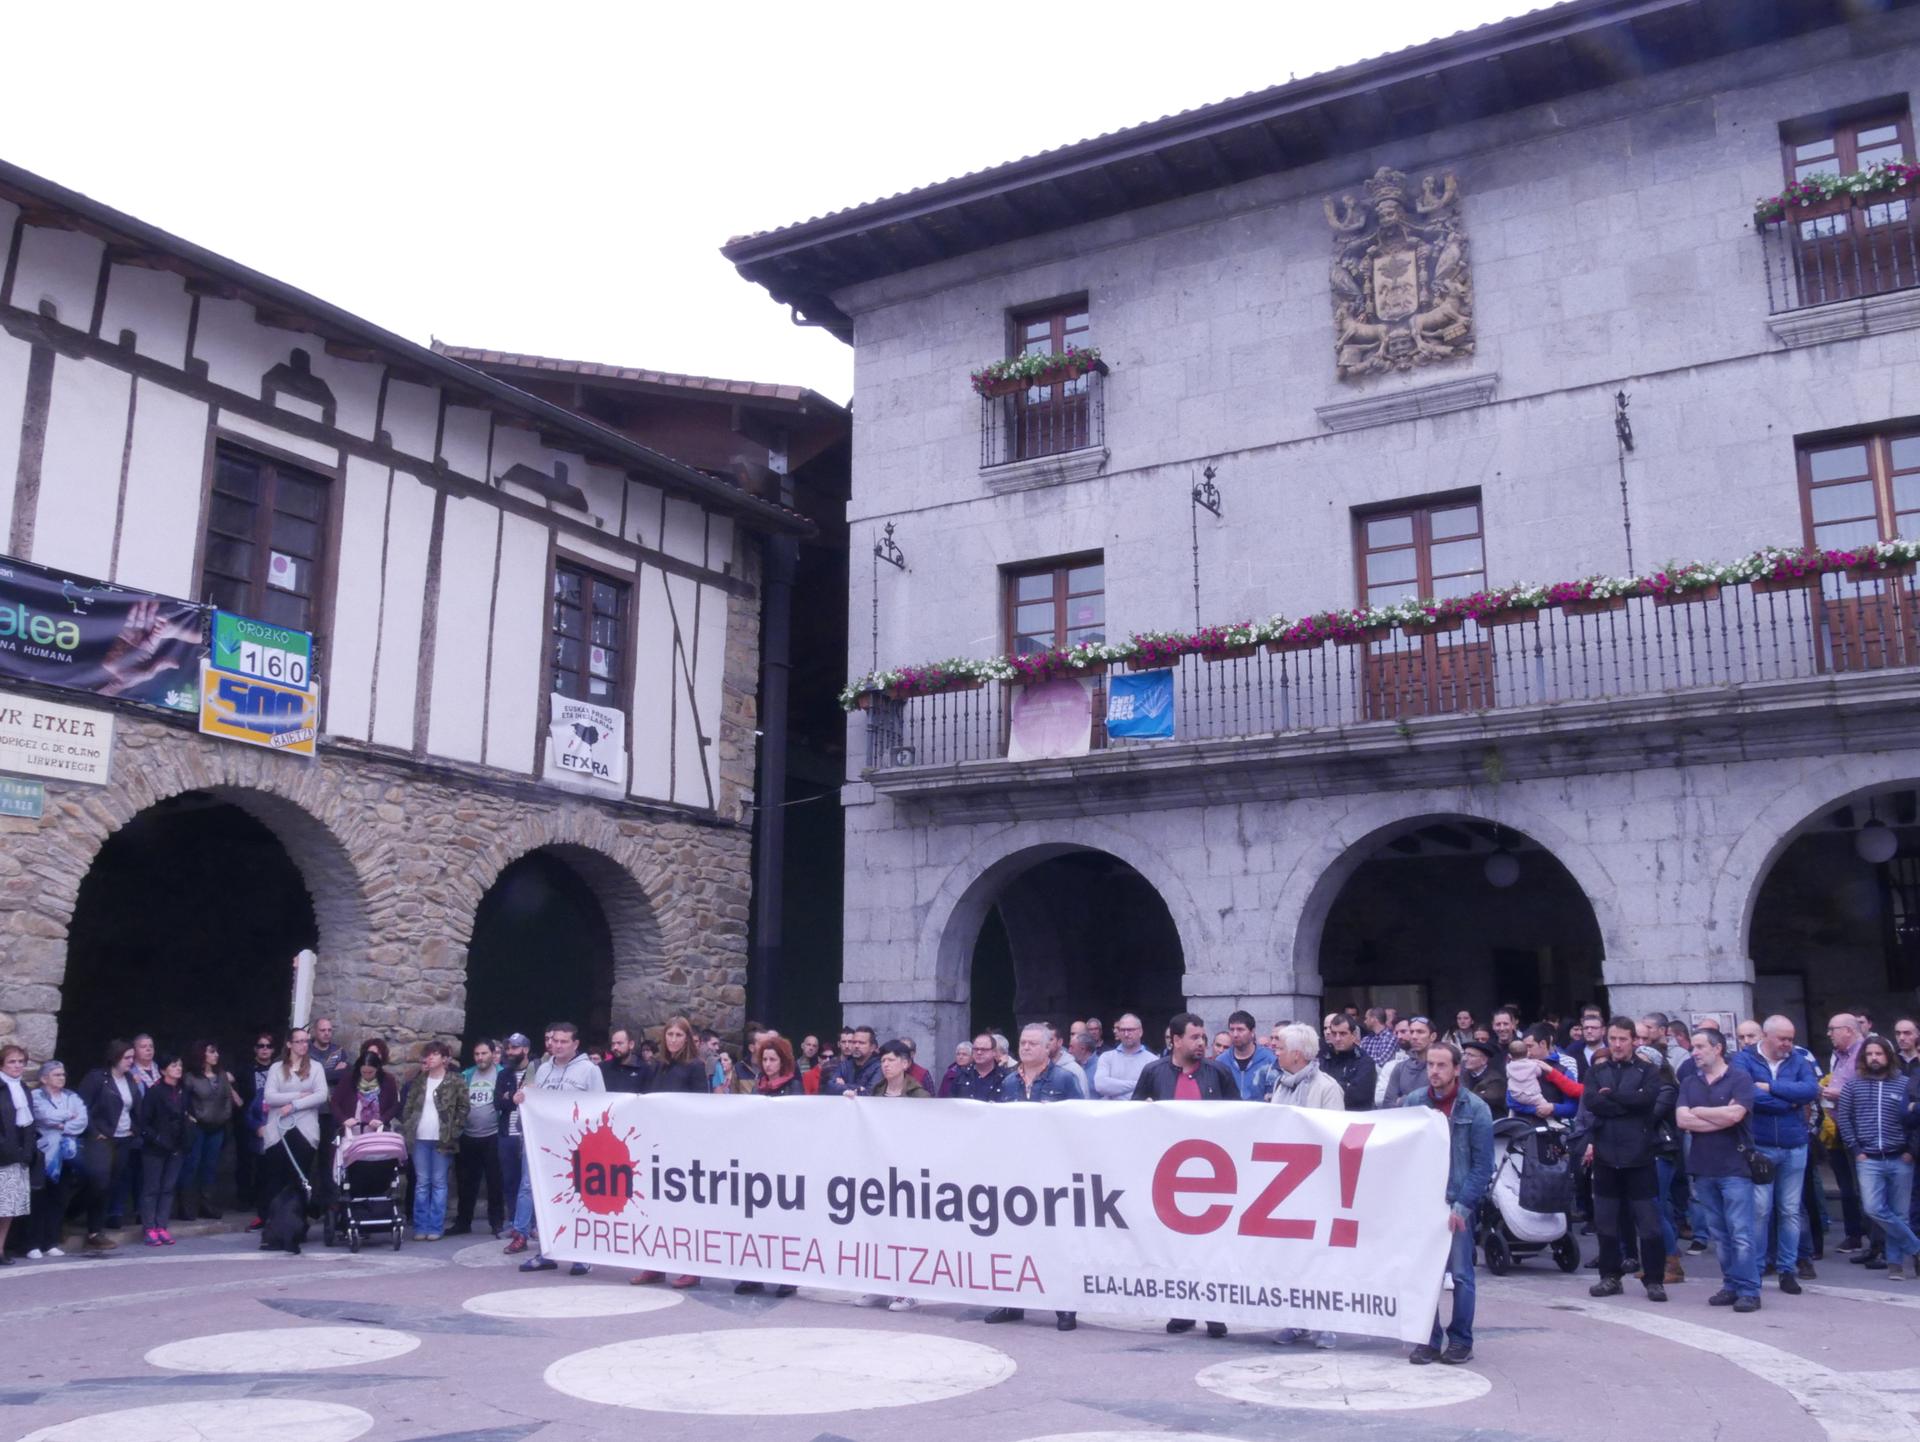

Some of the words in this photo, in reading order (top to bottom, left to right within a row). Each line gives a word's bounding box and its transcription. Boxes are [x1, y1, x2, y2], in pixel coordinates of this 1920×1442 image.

[237, 621, 290, 644] OROZKO
[23, 645, 73, 663] HUMANA
[246, 651, 304, 683] 160
[33, 713, 96, 738] ETXEA
[52, 743, 65, 754] DE
[67, 746, 101, 759] OLANO
[562, 753, 609, 777] ETXRA
[572, 1149, 634, 1199] lan
[651, 1154, 806, 1219] istripu
[827, 1166, 1130, 1237] gehiagorik
[1151, 1122, 1376, 1249] ez!
[573, 1217, 826, 1275] PREKARIETATEA
[837, 1240, 1046, 1294] HILTZAILEA
